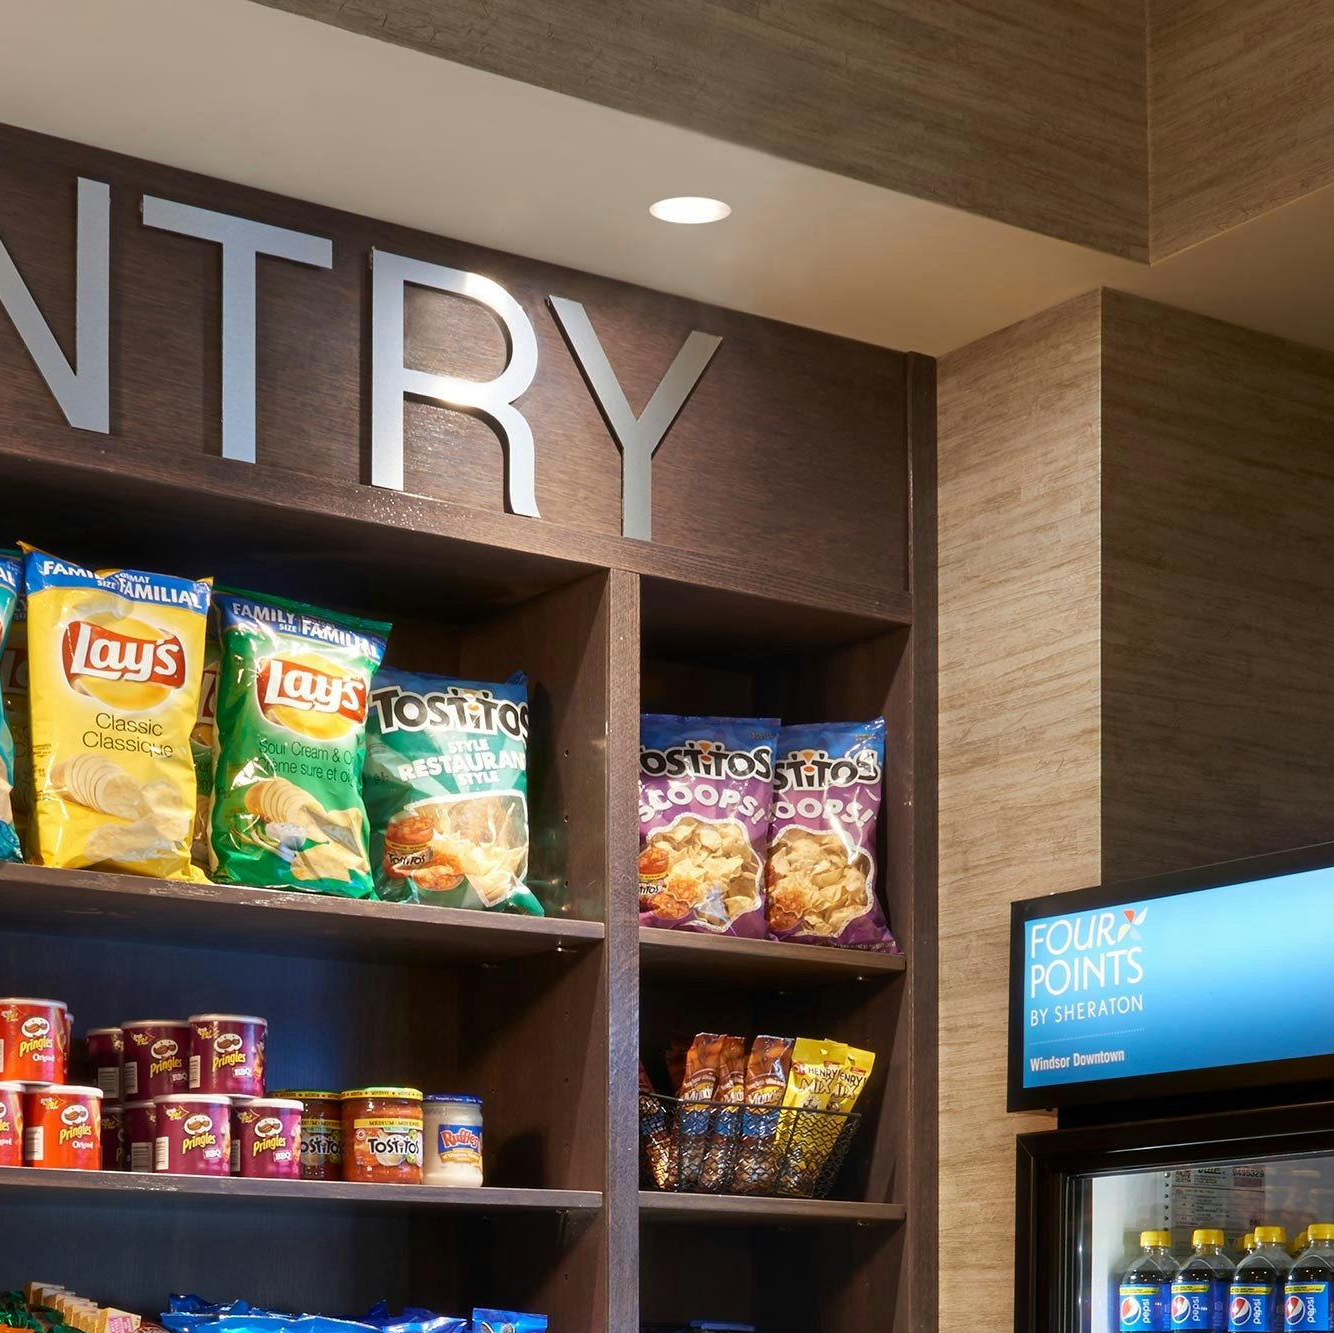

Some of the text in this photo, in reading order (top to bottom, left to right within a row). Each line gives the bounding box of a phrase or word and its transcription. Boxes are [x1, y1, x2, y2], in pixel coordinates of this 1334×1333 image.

[97, 579, 117, 590] SIZE
[120, 578, 203, 609] FAMILIAL
[232, 603, 381, 659] FAMILY FAMILIAL
[279, 623, 298, 633] SIZE
[71, 620, 181, 682] Lay's
[264, 659, 365, 714] Lay's
[95, 712, 164, 737] Classic
[81, 730, 174, 760] Classique
[259, 741, 287, 755] Sour
[291, 741, 329, 761] Cream
[332, 748, 341, 763] &
[447, 738, 490, 754] STYLE
[300, 762, 324, 779] sure
[327, 765, 338, 781] et
[457, 770, 500, 786] STYLE
[1031, 912, 1116, 959] FOUR
[1031, 946, 1144, 998] POINTS
[1030, 994, 1143, 1027] BY SHERATON
[19, 1036, 54, 1057] Pringles
[149, 1057, 183, 1078] Pringles
[211, 1050, 247, 1072] Pringles
[1030, 1049, 1125, 1072] Windsor Downtown
[808, 1066, 837, 1078] HENRY
[801, 1077, 832, 1095] MIX
[59, 1123, 92, 1145] Pringles
[182, 1132, 216, 1154] Pringles
[440, 1128, 480, 1148] Ruffles
[252, 1135, 287, 1157] Pringles
[1142, 1298, 1152, 1324] pepsi
[1192, 1297, 1201, 1322] pepsi
[1252, 1297, 1261, 1325] pepsi
[1306, 1296, 1316, 1323] pepsi
